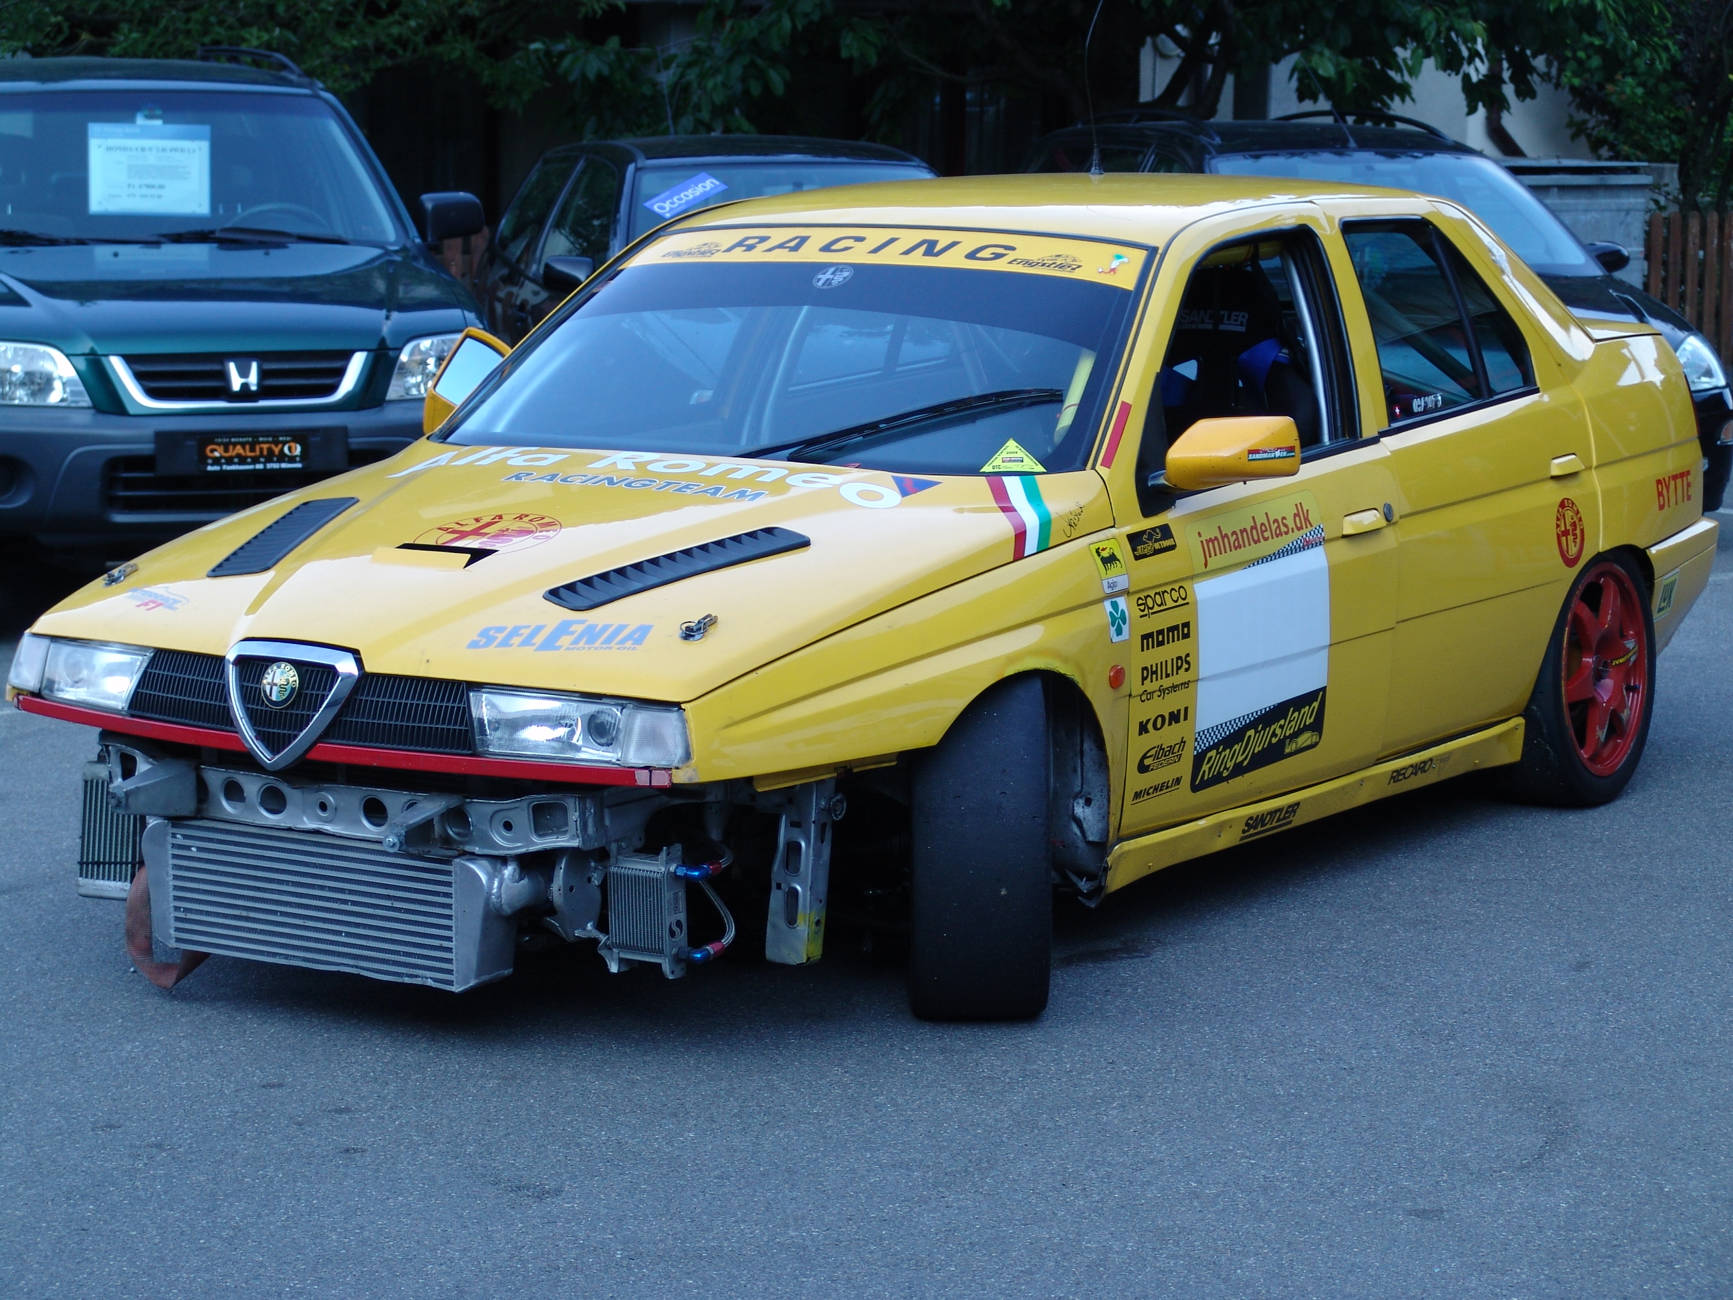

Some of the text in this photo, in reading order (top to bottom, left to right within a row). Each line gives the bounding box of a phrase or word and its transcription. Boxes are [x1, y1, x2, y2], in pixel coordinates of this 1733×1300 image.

[653, 177, 720, 213] Occasion
[721, 235, 1017, 262] RACING
[205, 443, 283, 458] QUALITY
[390, 446, 902, 509] Alfa Romeo
[503, 472, 768, 501] RACINGTEAM
[1656, 470, 1692, 512] BYTTE
[1197, 502, 1313, 569] jmhandelas.dk
[1136, 585, 1188, 619] sparco
[465, 619, 654, 652] SELENIA
[1140, 621, 1191, 652] momo
[1141, 653, 1192, 686] PHILIPS
[1139, 680, 1191, 703] Car Systems
[1138, 706, 1189, 736] KONI
[1195, 691, 1323, 785] RingDjursland
[1137, 736, 1187, 774] Eibach
[1387, 758, 1434, 785] RECARO
[1132, 776, 1183, 802] MICHELIN
